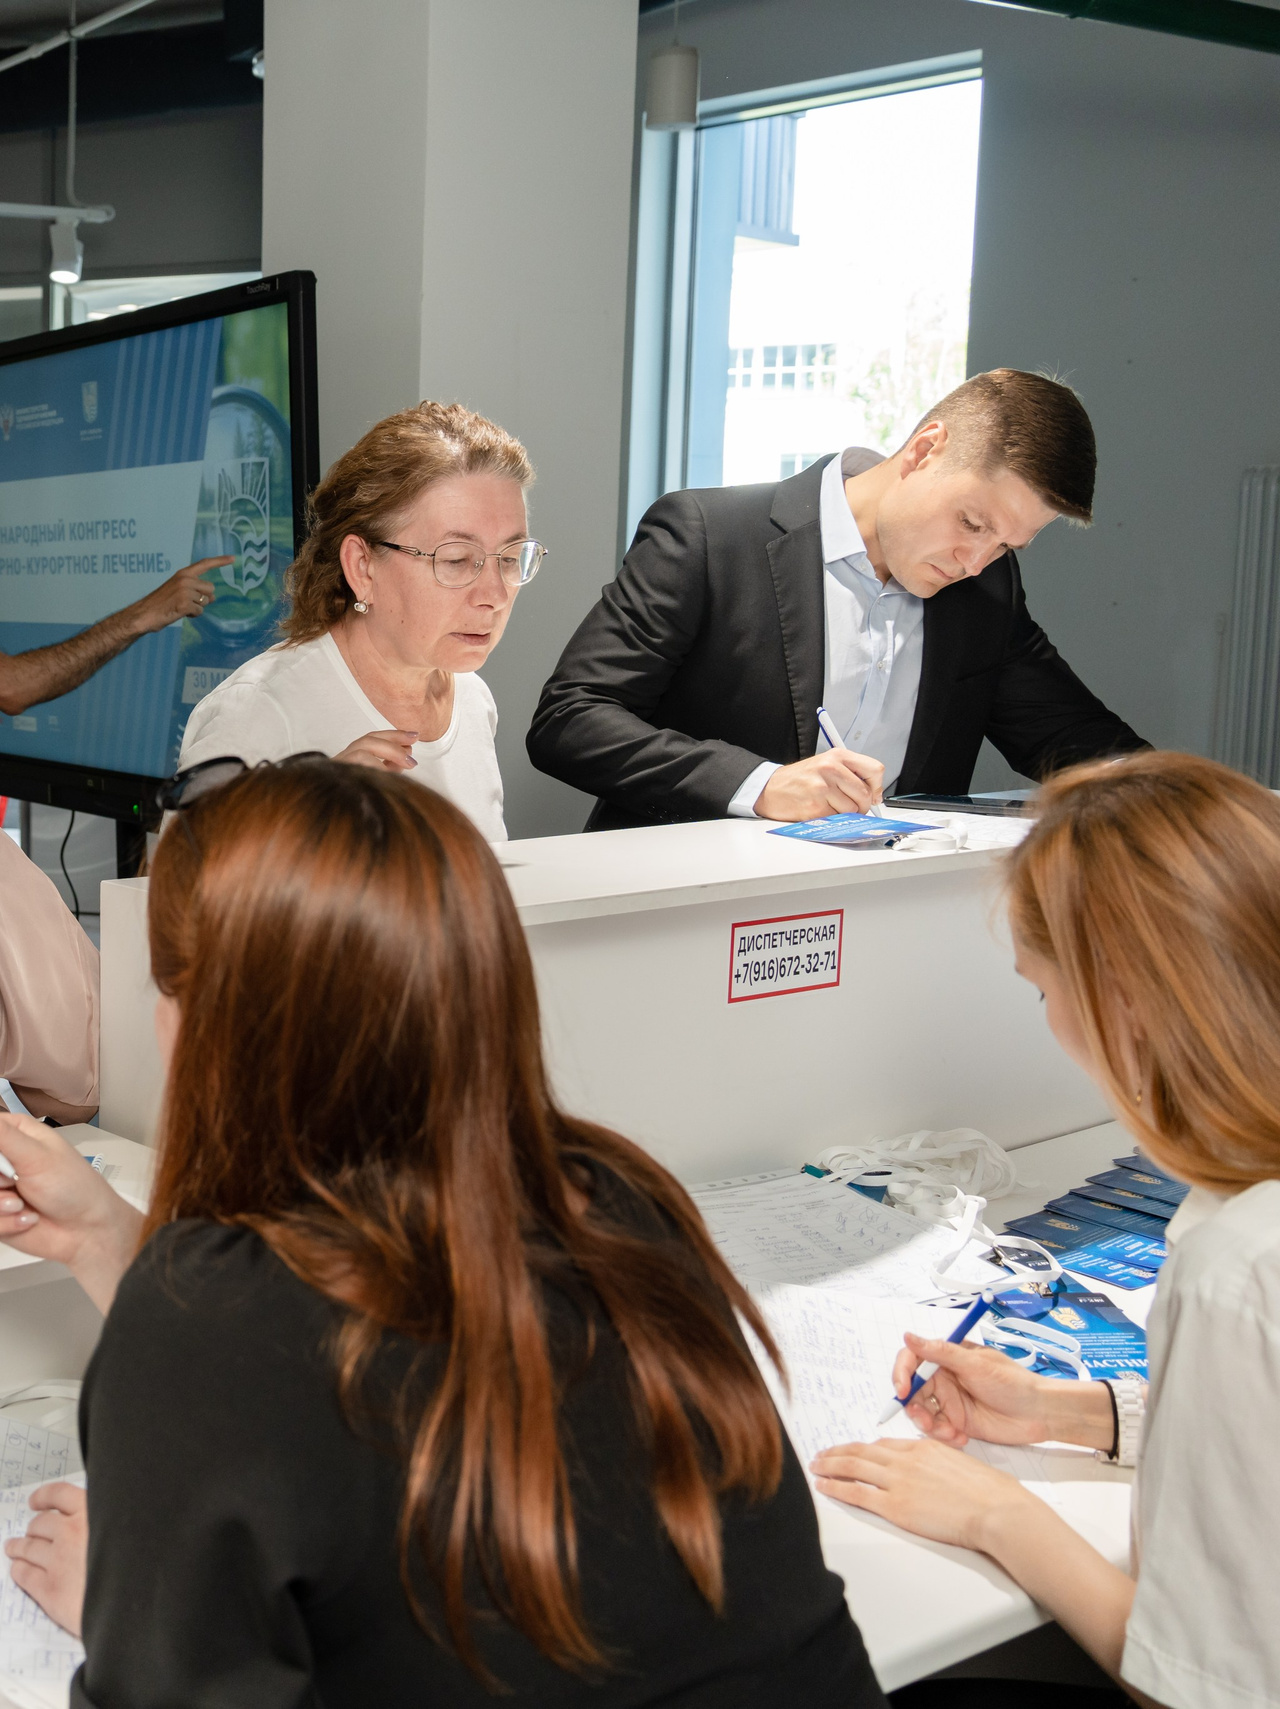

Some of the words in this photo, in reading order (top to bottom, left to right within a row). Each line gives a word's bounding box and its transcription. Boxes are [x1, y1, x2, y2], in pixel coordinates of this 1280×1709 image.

[68, 518, 137, 541] КОНГРЕСС
[101, 552, 172, 575] ЛЕЧЕНИЕ»
[192, 670, 207, 689] 30
[737, 923, 837, 957] ДИСПЕТЧЕРСКАЯ
[733, 949, 837, 986] +7(916)672-32-71
